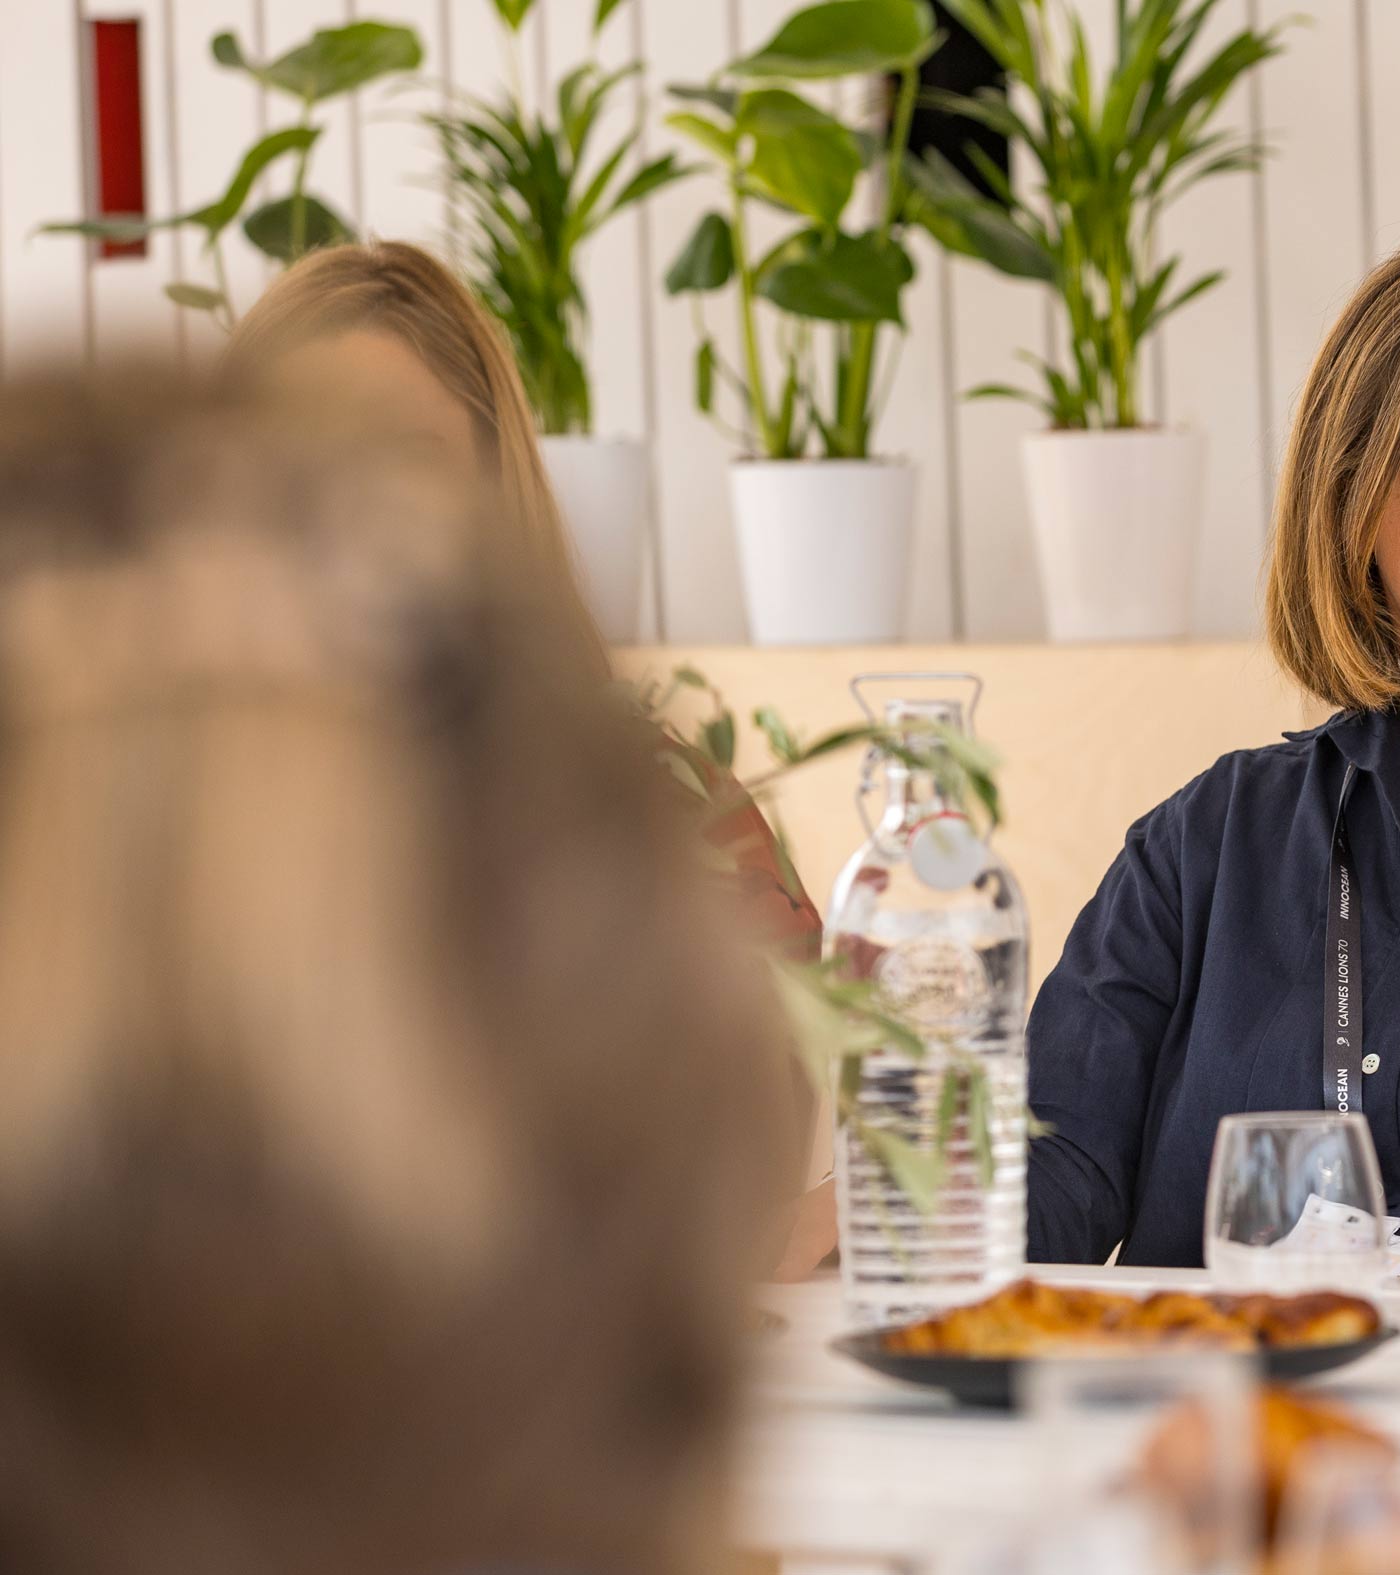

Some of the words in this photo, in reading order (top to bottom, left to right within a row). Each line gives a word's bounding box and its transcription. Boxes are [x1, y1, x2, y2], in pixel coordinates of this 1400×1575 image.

[1340, 865, 1350, 920] INNOCEAN
[1338, 939, 1349, 953] 70
[1338, 953, 1349, 984] LIONS
[1338, 985, 1349, 1027] CANNES
[1337, 1068, 1349, 1119] NOCEAN
